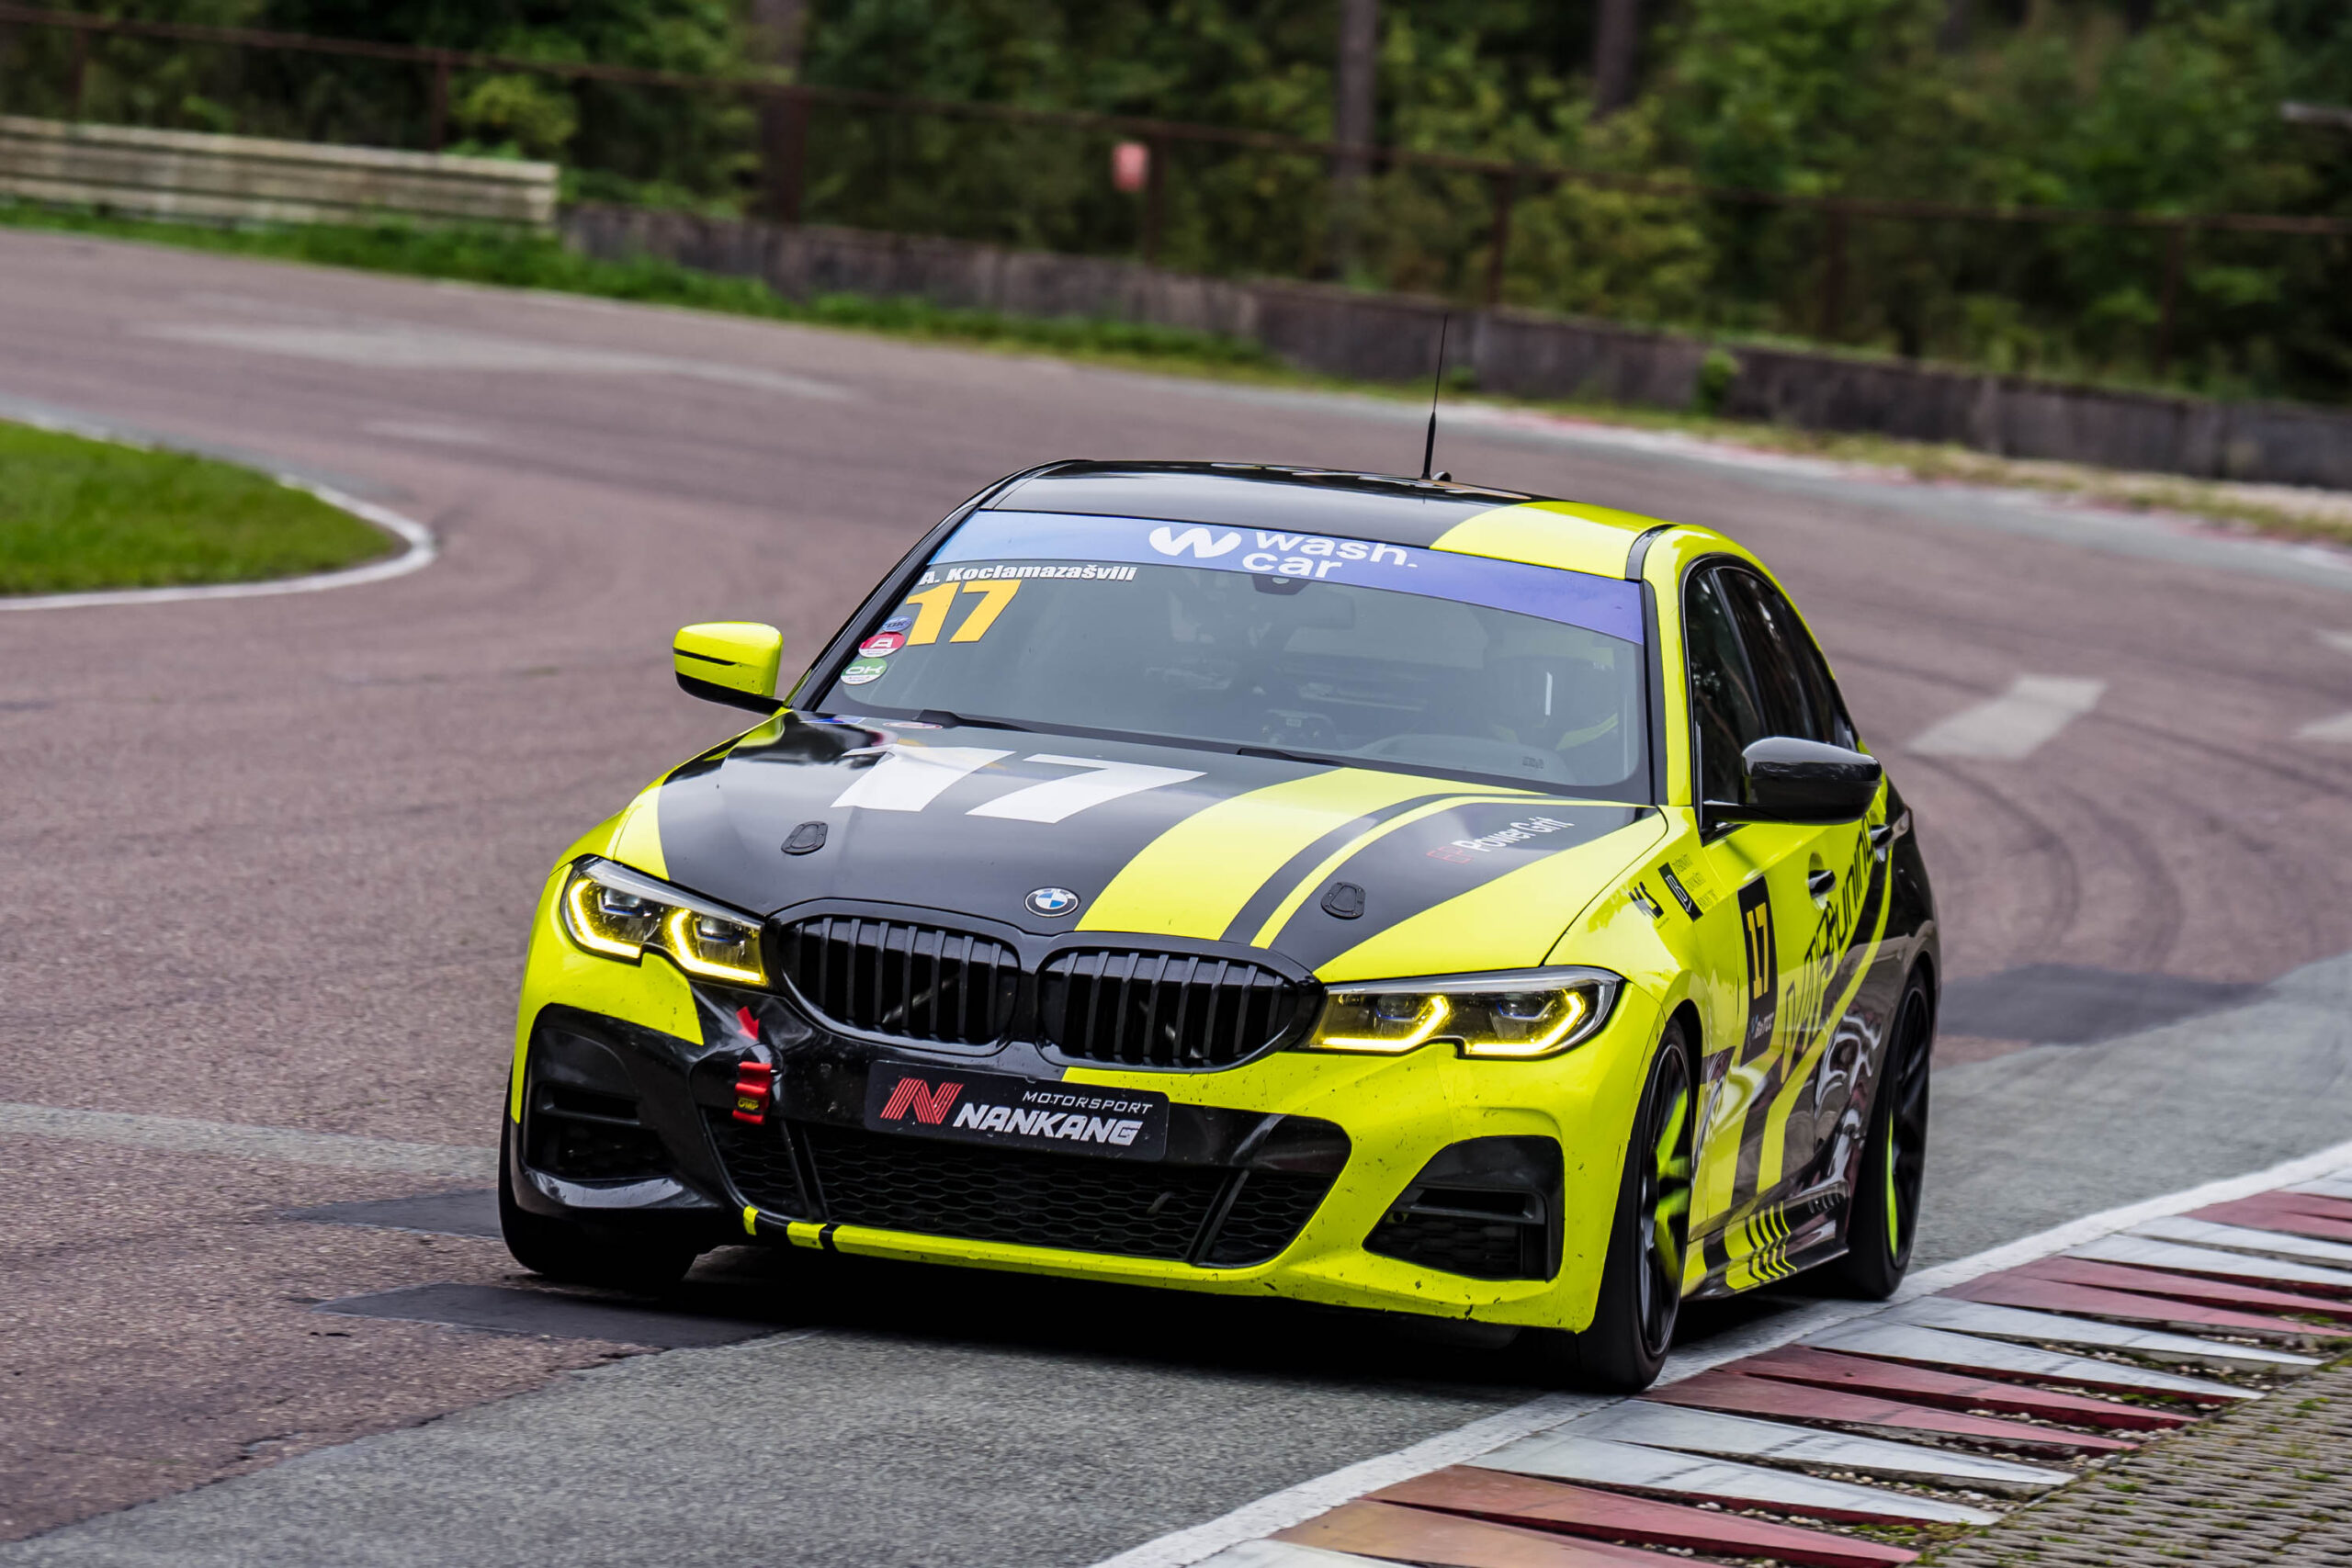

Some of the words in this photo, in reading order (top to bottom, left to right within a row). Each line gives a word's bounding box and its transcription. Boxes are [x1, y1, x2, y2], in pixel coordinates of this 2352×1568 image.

[1243, 552, 1342, 578] car
[1256, 532, 1419, 568] wash.
[918, 571, 940, 585] A.
[944, 564, 1138, 582] Koclamazašvili
[906, 580, 1022, 646] 17
[832, 743, 1208, 824] 17
[1451, 828, 1536, 852] Power
[1747, 902, 1770, 999] 17
[1022, 1090, 1154, 1114] MOTORSPORT
[953, 1102, 1144, 1146] NANKANG
